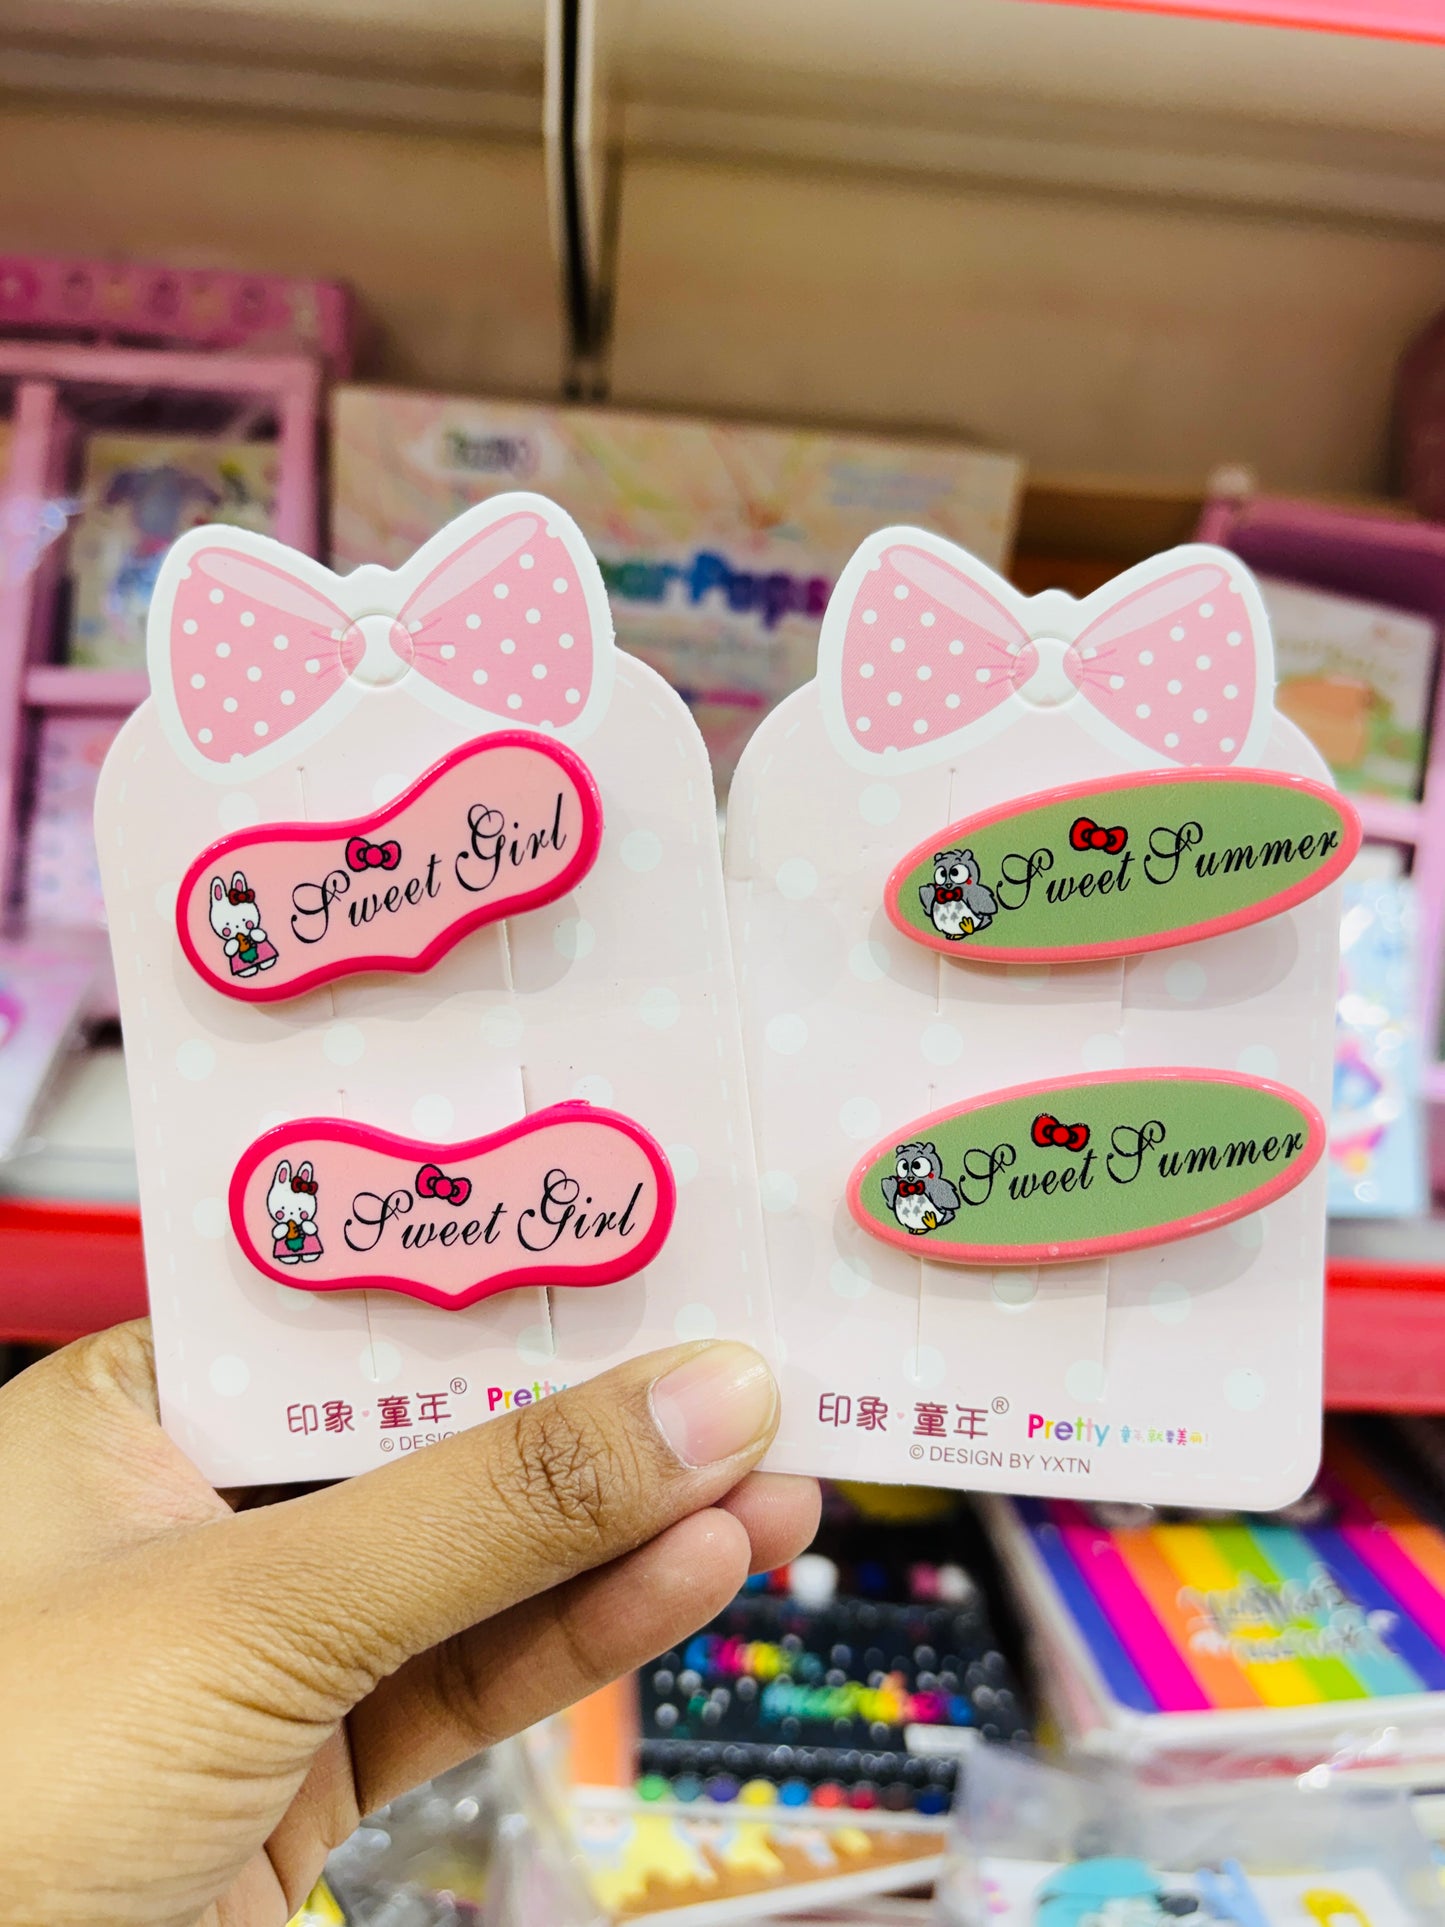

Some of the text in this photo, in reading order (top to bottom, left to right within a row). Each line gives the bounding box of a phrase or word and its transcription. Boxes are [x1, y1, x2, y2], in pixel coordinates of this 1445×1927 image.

[290, 792, 567, 944] Sweet Girl
[996, 820, 1339, 911] Sweet Summer
[960, 1119, 1303, 1206] Sweet Summer
[343, 1168, 644, 1252] Sweet Girl
[400, 1431, 461, 1451] DESI
[929, 1446, 1003, 1468] DESIGN
[1009, 1453, 1035, 1470] BY
[1040, 1455, 1091, 1474] YXTN
[1028, 1413, 1110, 1447] Pretty
